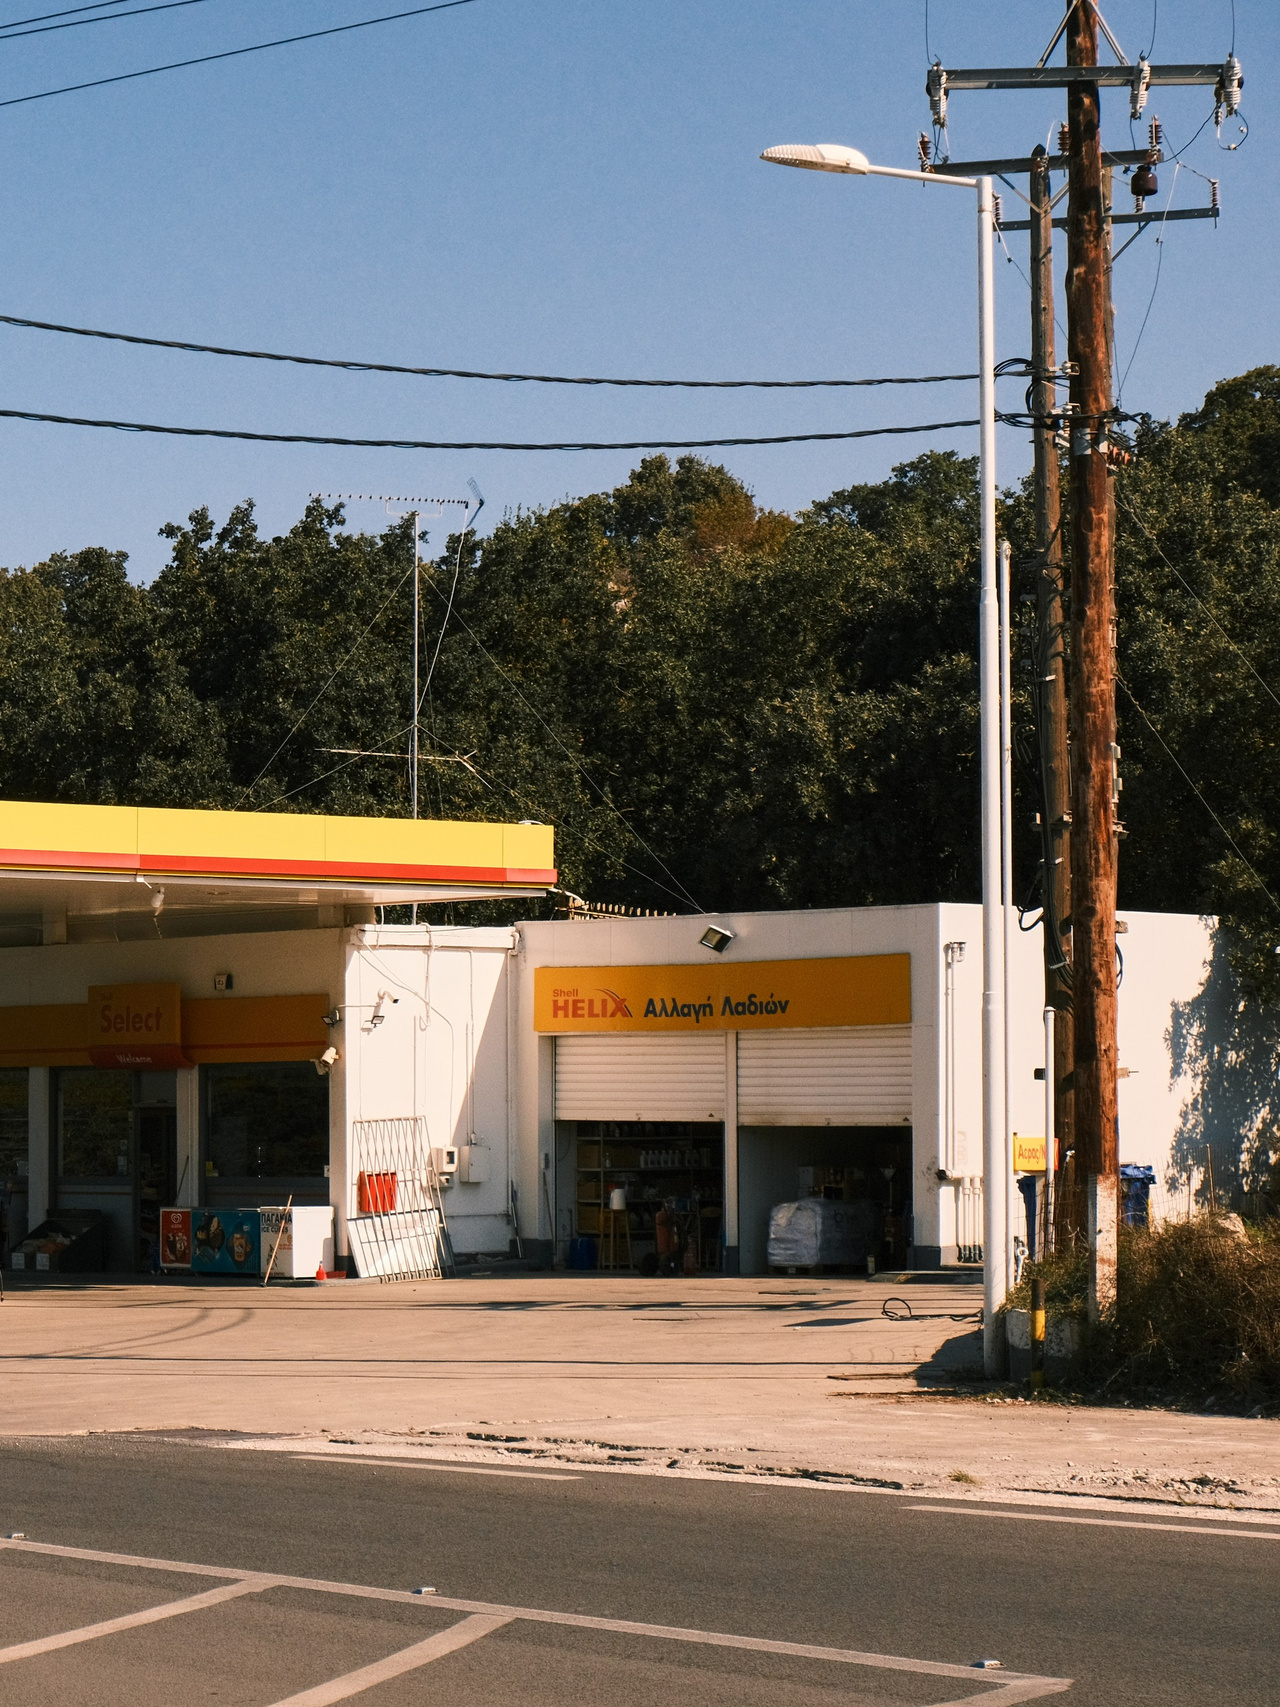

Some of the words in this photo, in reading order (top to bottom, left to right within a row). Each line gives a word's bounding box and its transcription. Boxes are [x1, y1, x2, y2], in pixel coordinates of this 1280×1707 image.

[552, 988, 579, 998] Shell
[100, 1004, 163, 1034] Select
[552, 997, 631, 1019] HELIX
[643, 995, 714, 1024] Αλλαγή
[720, 992, 790, 1017] Λαδιών
[115, 1053, 153, 1064] Welcome
